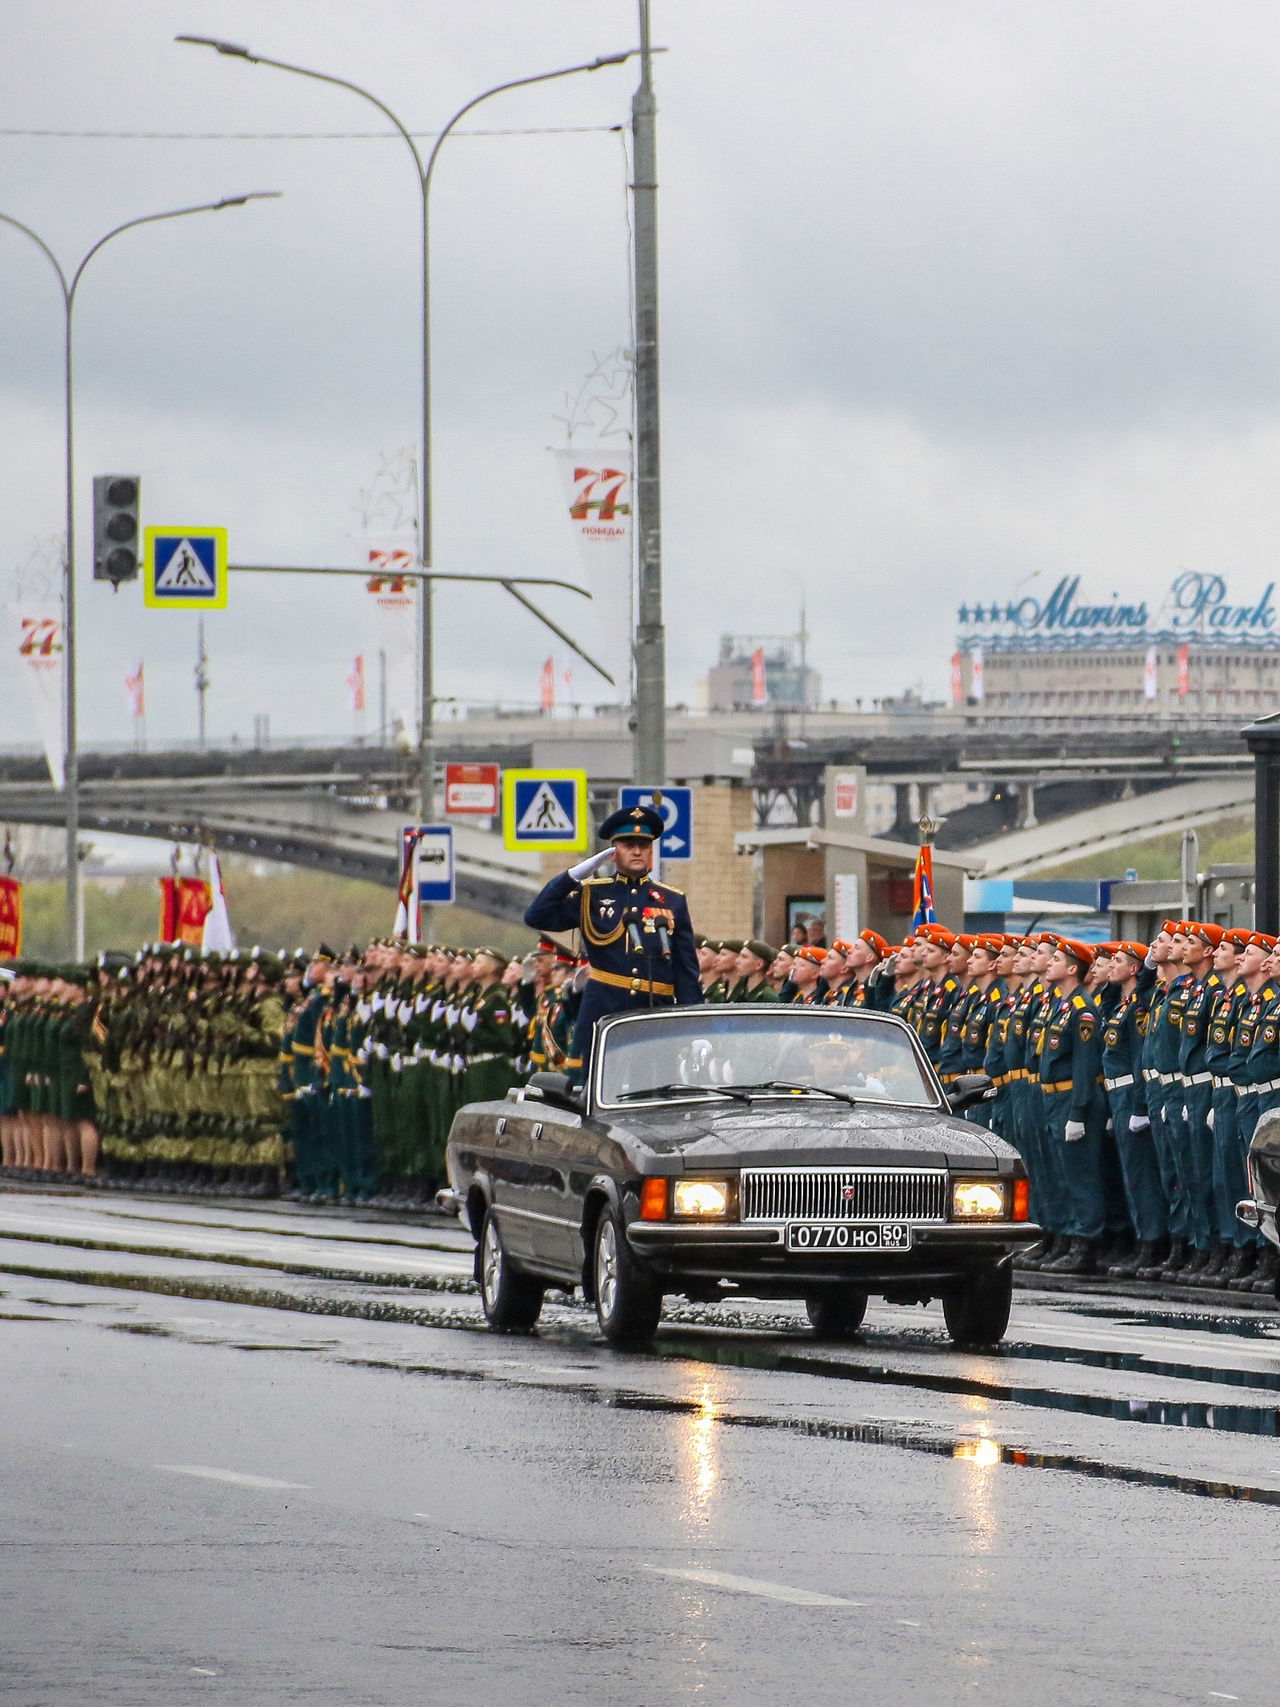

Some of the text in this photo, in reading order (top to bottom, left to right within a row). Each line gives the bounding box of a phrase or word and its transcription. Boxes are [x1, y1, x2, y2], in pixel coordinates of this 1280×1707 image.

[570, 468, 628, 520] 77
[1015, 574, 1149, 630] Marins
[1171, 570, 1277, 628] Park
[797, 1226, 849, 1247] 0770
[882, 1225, 903, 1241] 50
